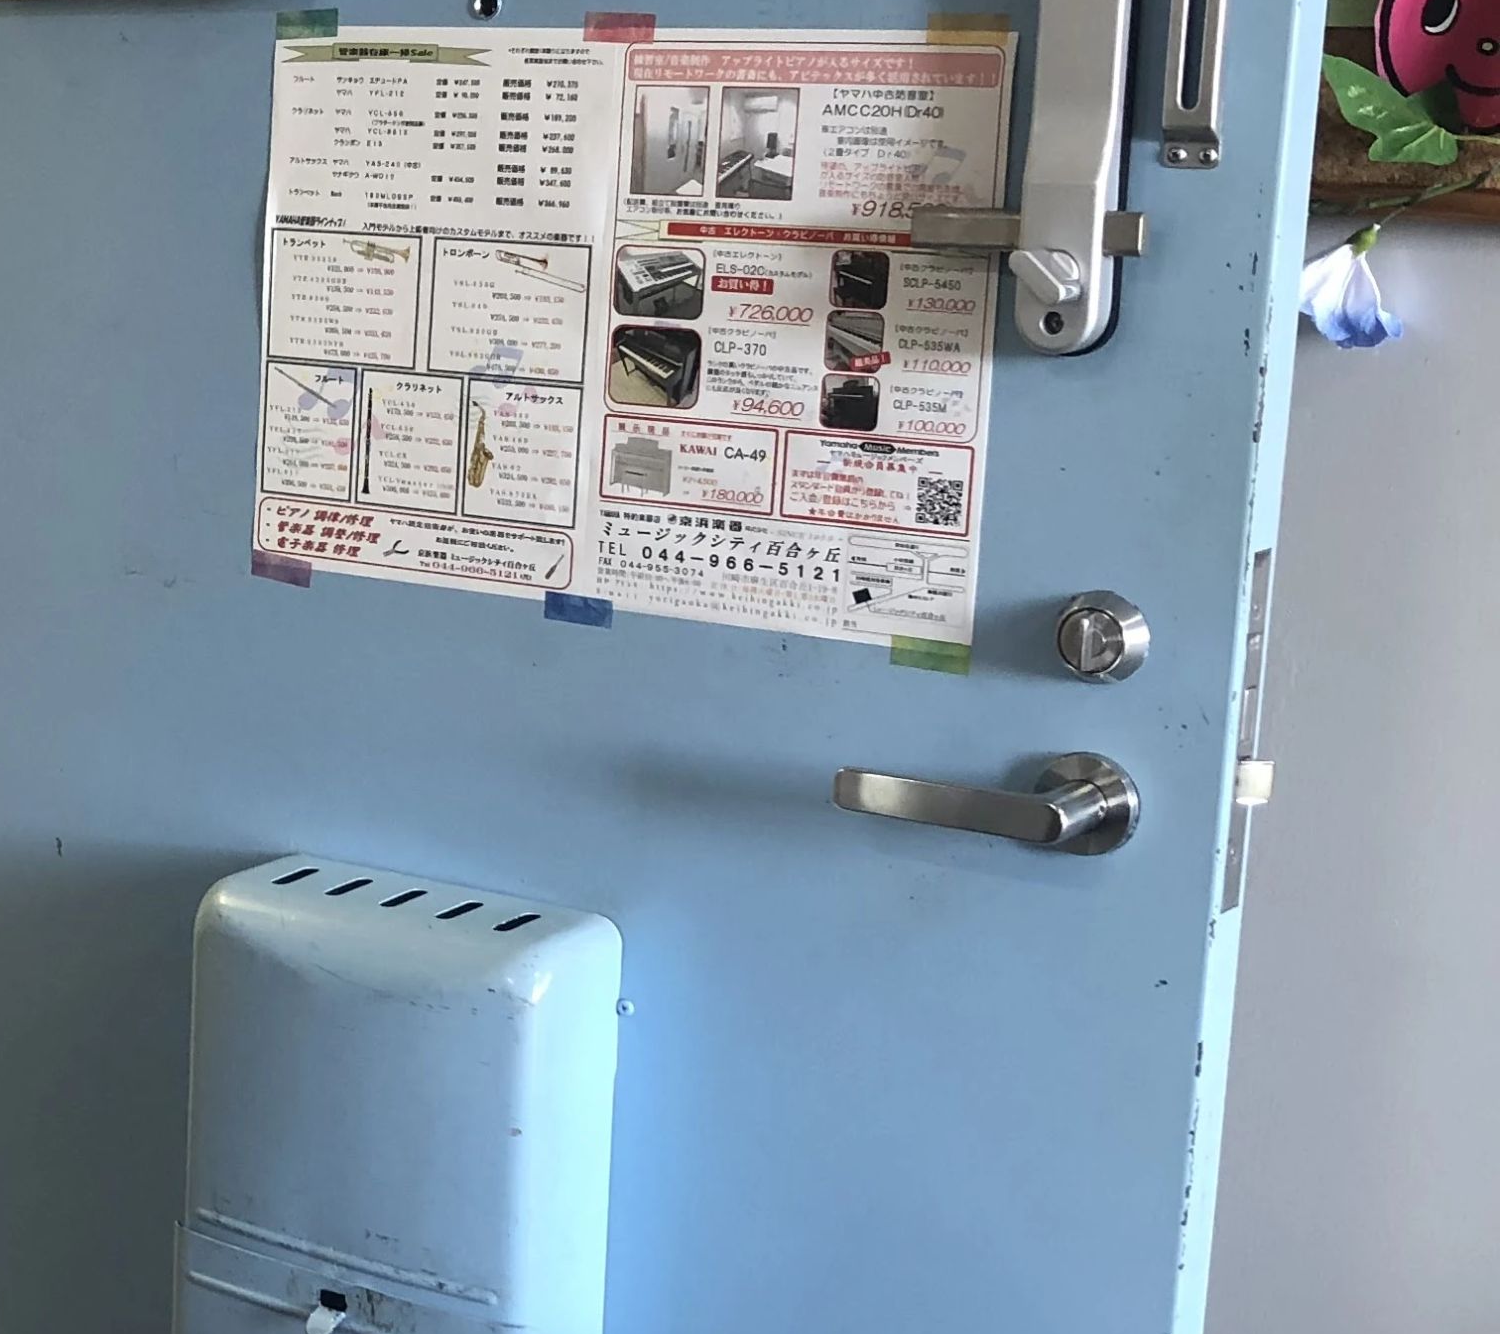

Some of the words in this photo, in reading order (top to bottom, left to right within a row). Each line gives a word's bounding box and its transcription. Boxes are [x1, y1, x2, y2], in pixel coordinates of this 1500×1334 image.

[283, 237, 326, 249] トランペット
[443, 247, 490, 259] トロンボーン
[716, 263, 765, 276] ELS-02C
[717, 278, 769, 292] お買い得!
[714, 341, 767, 355] CLP-370
[898, 338, 960, 353] CLP-535WA
[314, 374, 345, 385] フルート
[396, 381, 443, 394] クラリネット
[505, 392, 564, 405] アルトサックス
[893, 399, 947, 413] CLP-535M
[732, 397, 805, 417] ¥94,600
[679, 443, 717, 457] KAWAI
[724, 447, 767, 463] CA-49
[820, 439, 859, 450] Yamaha
[864, 443, 893, 453] Music
[896, 447, 940, 458] Members
[276, 505, 310, 518] ピアノ
[313, 509, 375, 528] 調律/修理
[678, 515, 743, 533] 京浜楽器
[276, 520, 316, 536] 管楽器
[320, 526, 381, 545] 調整/修理
[276, 536, 328, 553] 電子楽器
[332, 543, 361, 558] 修理
[598, 540, 627, 557] TEL
[642, 545, 841, 583] 044-966-5121
[598, 556, 613, 567] FAX
[619, 560, 704, 578] 044-955-3074
